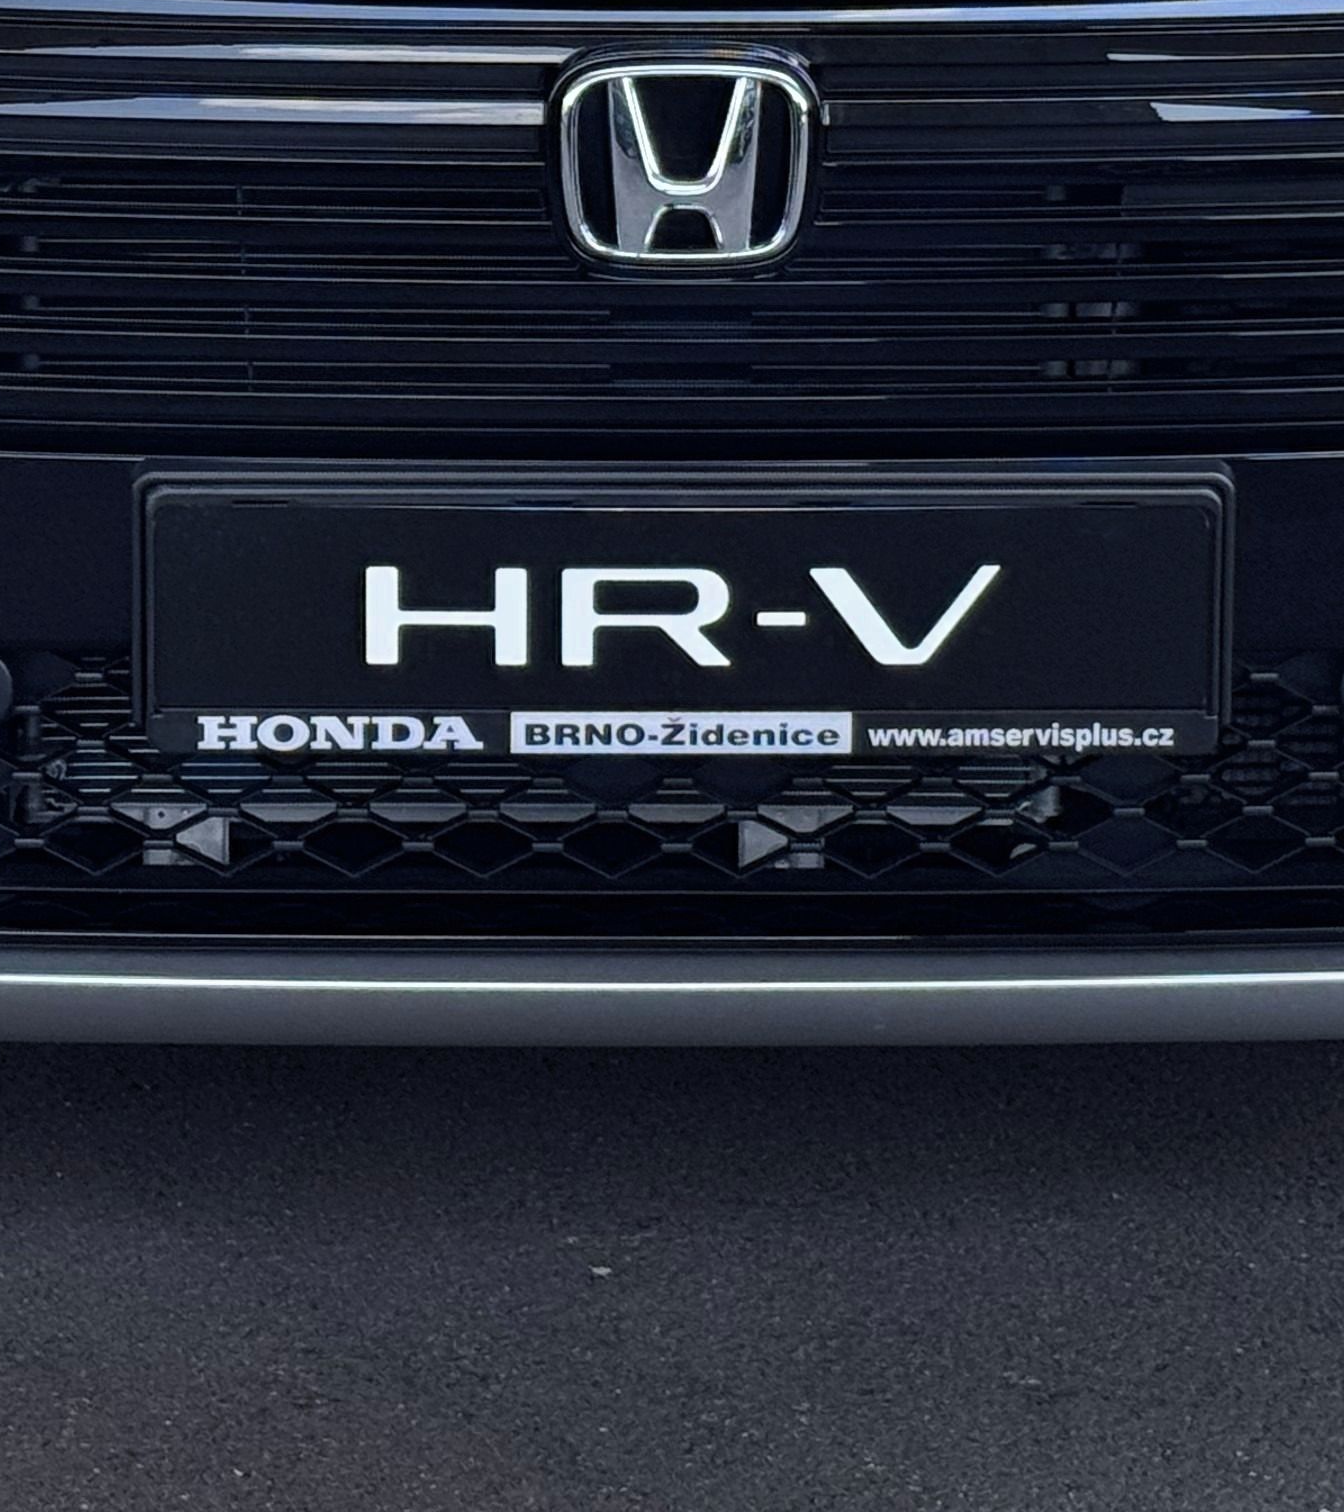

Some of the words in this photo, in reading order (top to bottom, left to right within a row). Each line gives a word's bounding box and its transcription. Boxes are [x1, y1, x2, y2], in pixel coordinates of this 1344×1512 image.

[365, 565, 1001, 666] HR-V
[197, 715, 484, 751] HONDA
[524, 716, 841, 747] BRNO-Židenice
[867, 723, 1175, 752] www.amservisplus.cz
